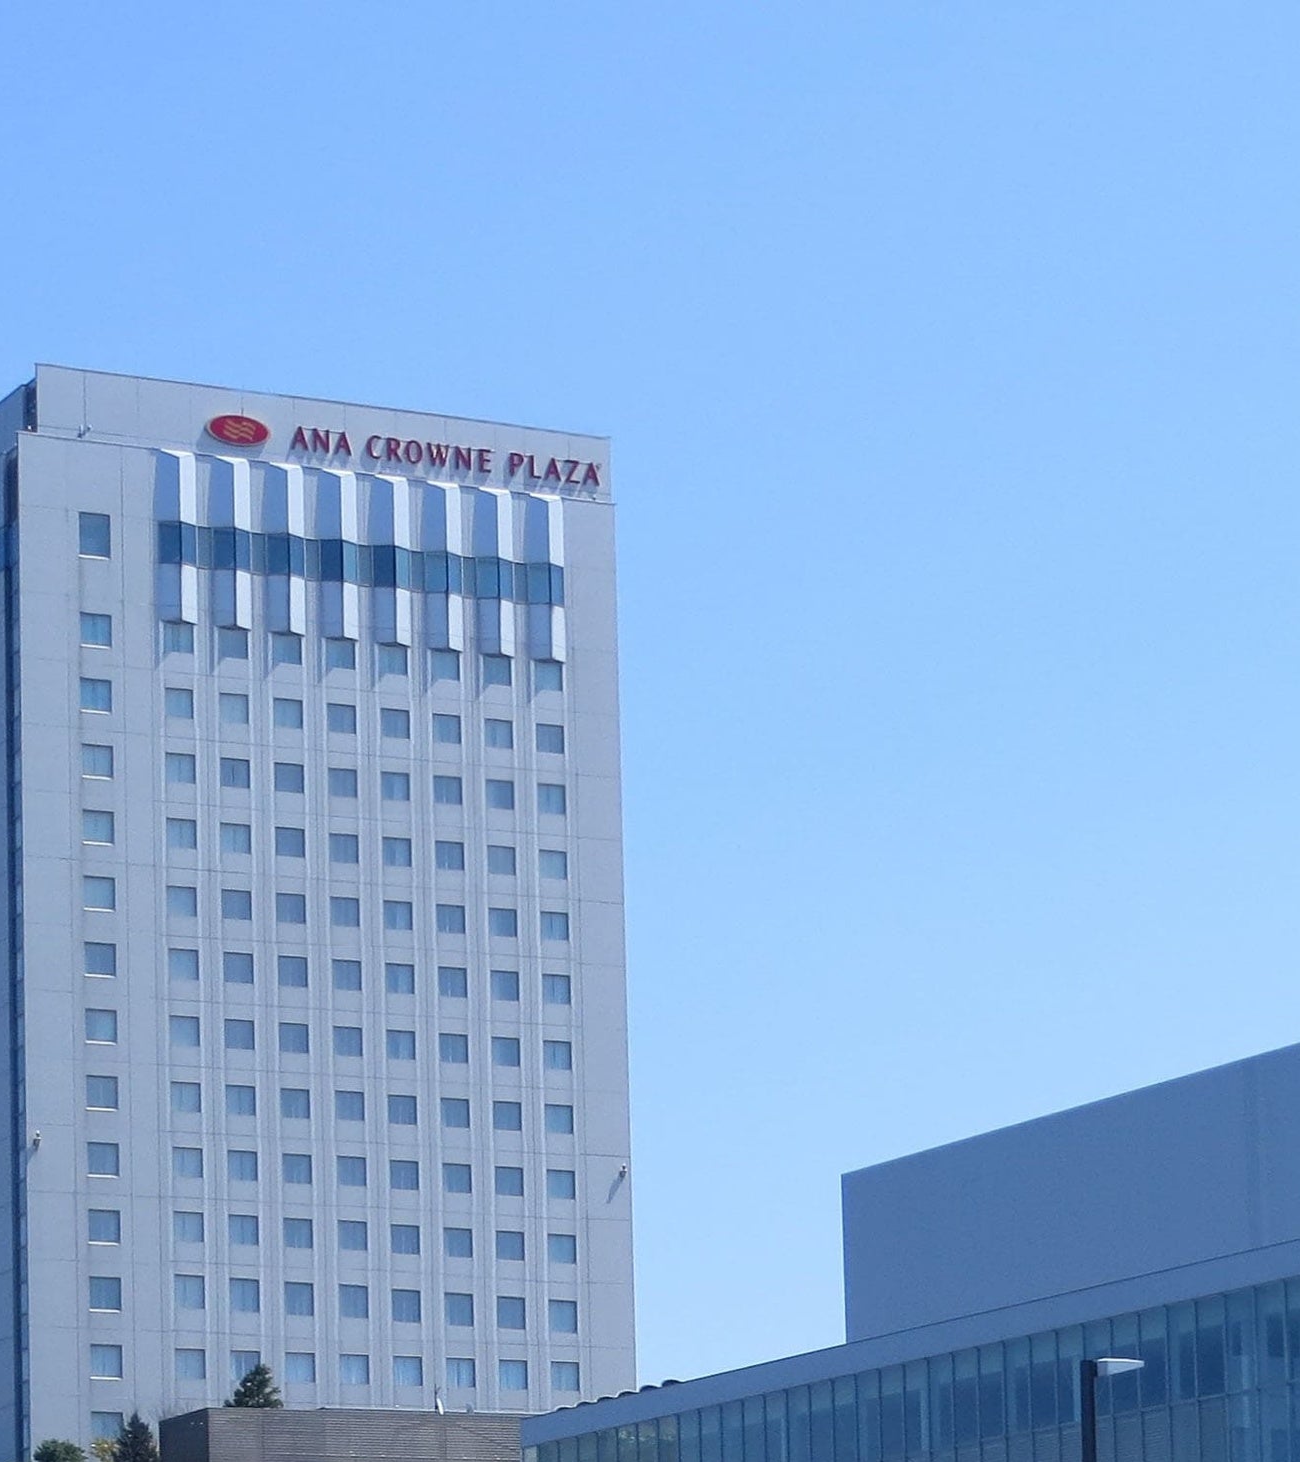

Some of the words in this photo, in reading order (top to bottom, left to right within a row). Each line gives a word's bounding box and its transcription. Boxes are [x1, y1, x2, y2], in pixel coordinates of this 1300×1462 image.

[291, 426, 352, 456] ANA
[366, 435, 492, 473] CROWNE
[509, 452, 599, 486] PLAZA
